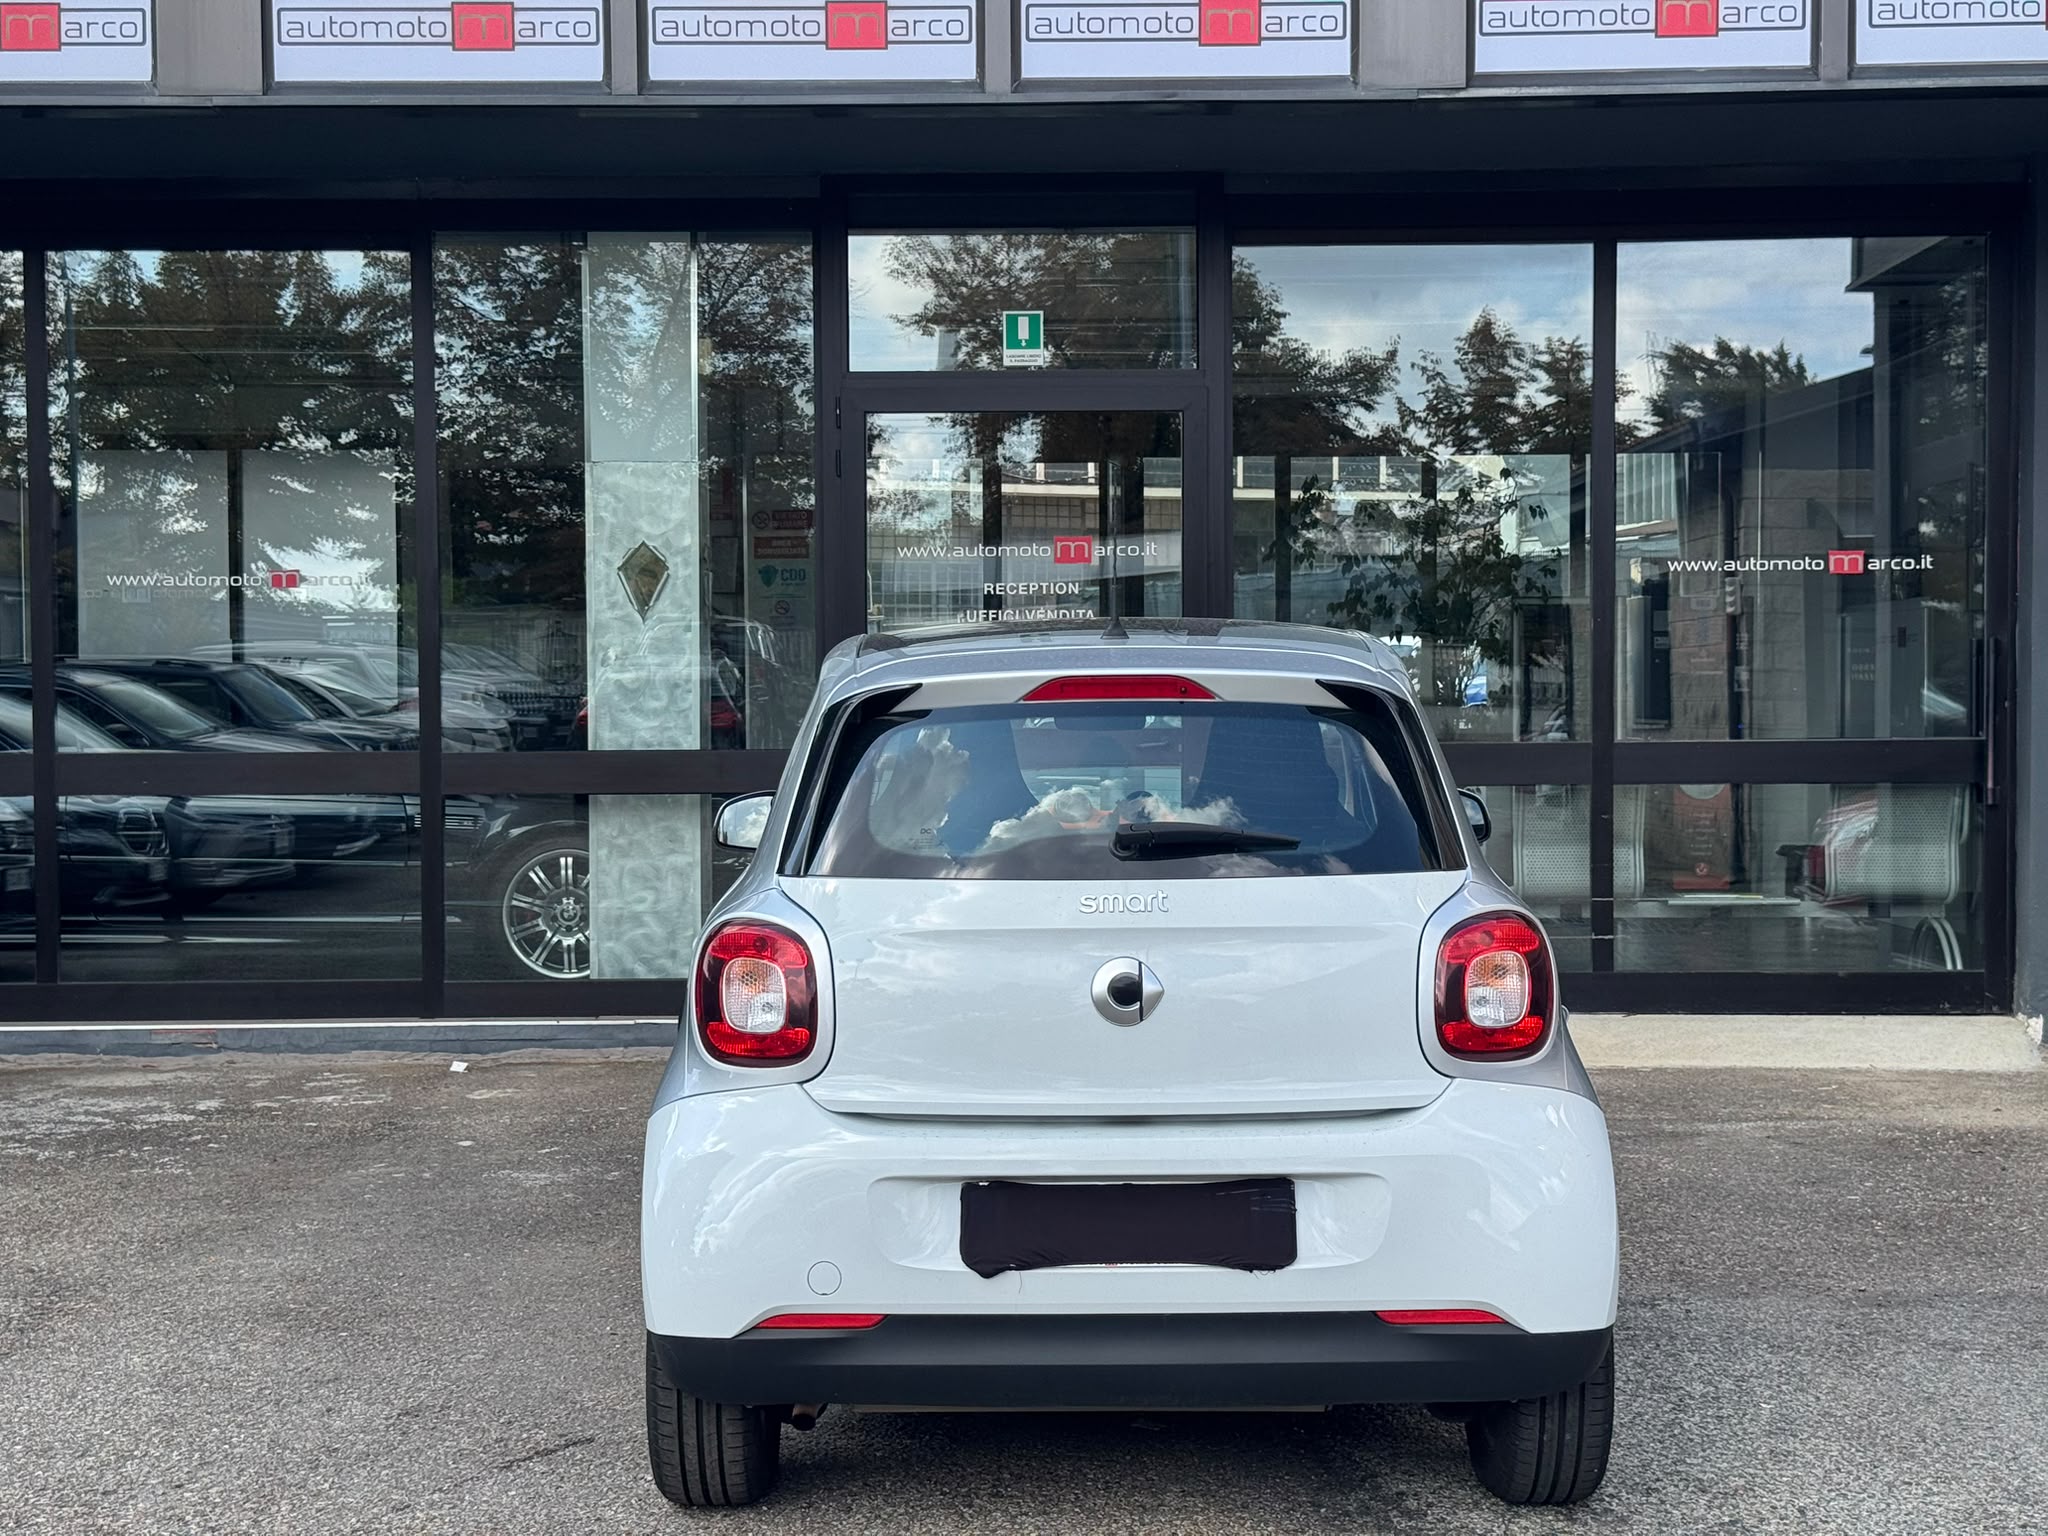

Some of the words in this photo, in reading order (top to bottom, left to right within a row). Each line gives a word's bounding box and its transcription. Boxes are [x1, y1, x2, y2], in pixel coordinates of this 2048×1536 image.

[983, 582, 1080, 595] RECEPTION
[966, 609, 1021, 623] UFFICI
[1079, 889, 1169, 914] smart
